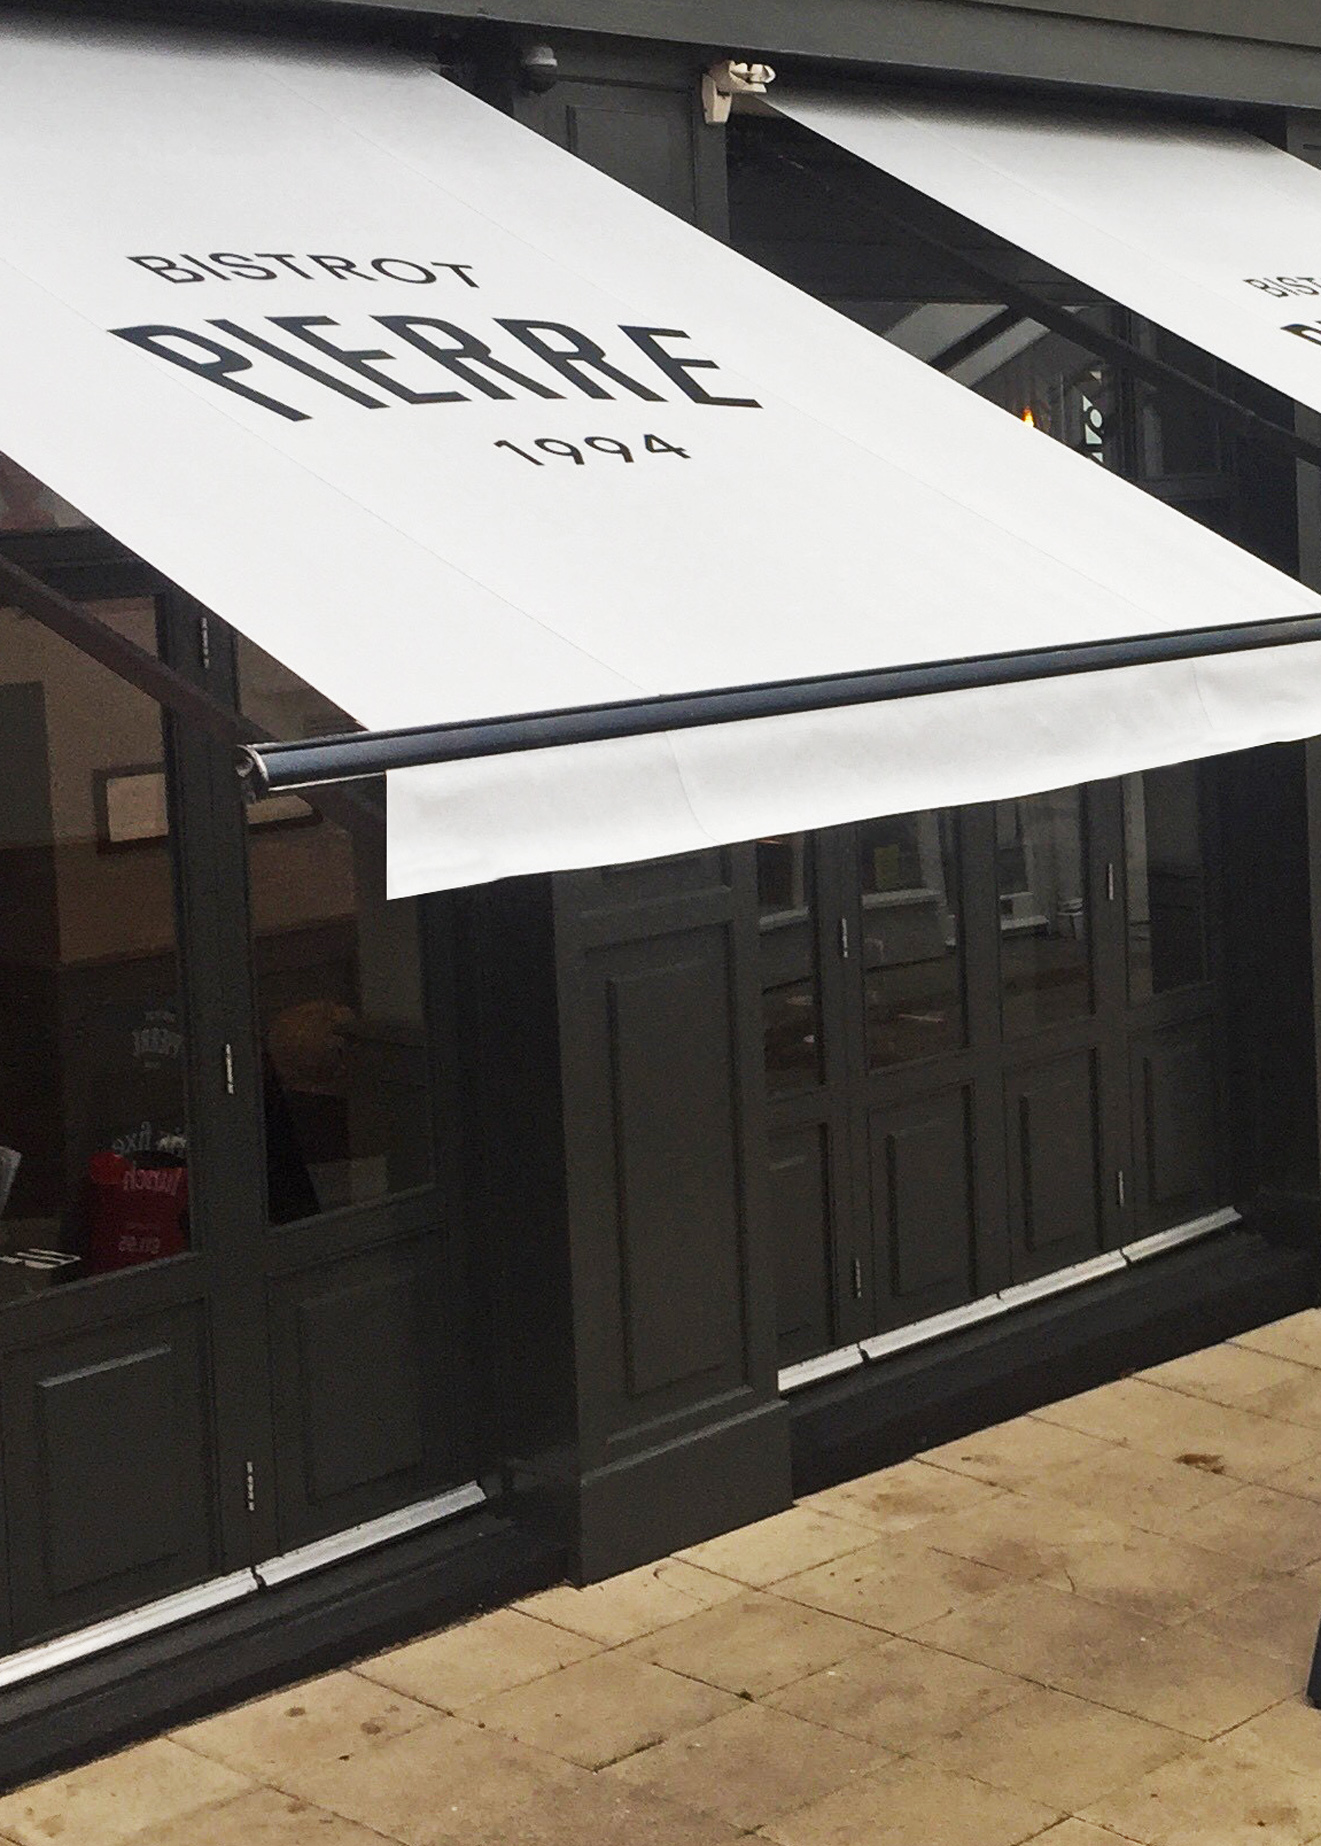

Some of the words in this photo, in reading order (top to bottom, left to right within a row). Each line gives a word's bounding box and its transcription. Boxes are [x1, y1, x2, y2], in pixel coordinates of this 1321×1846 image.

[126, 252, 480, 289] BISTROT
[106, 314, 764, 423] PIERRE
[493, 433, 692, 467] 1994
